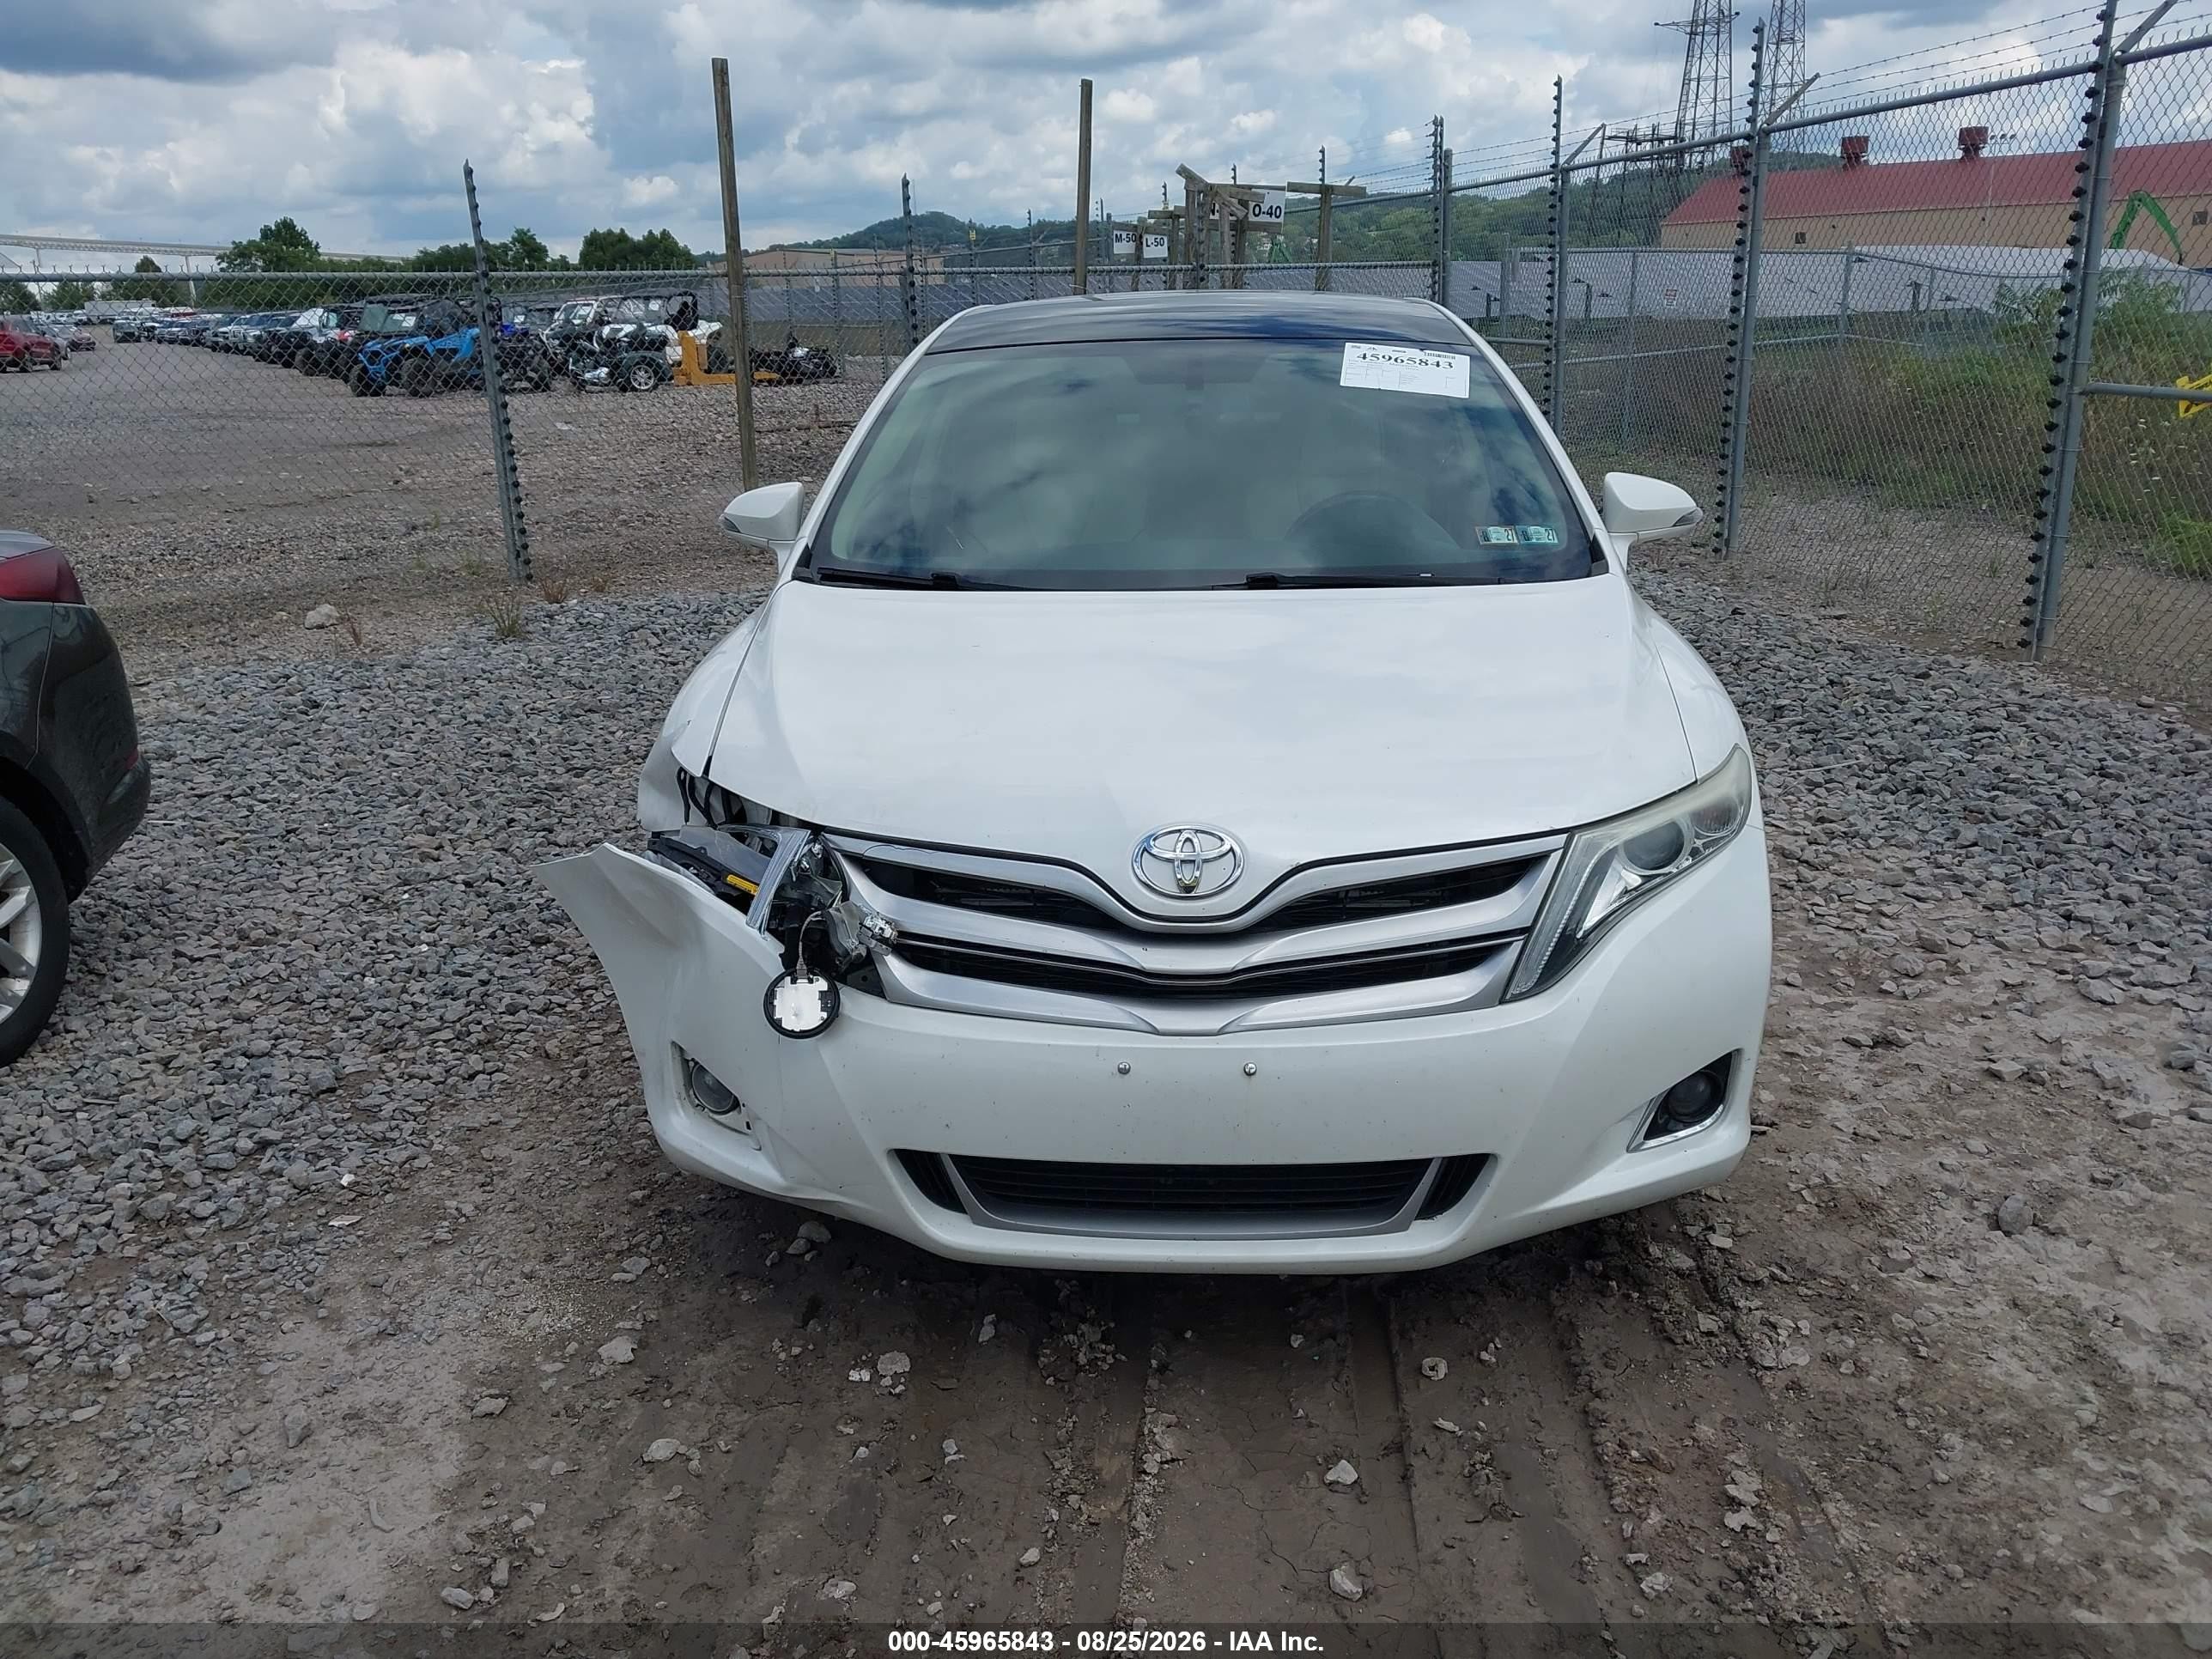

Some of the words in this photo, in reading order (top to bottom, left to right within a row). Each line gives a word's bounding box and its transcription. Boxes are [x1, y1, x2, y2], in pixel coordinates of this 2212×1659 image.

[1252, 203, 1282, 219] O-40
[1115, 233, 1137, 244] M-50
[1145, 237, 1165, 248] L-50
[1357, 352, 1454, 370] 45965843
